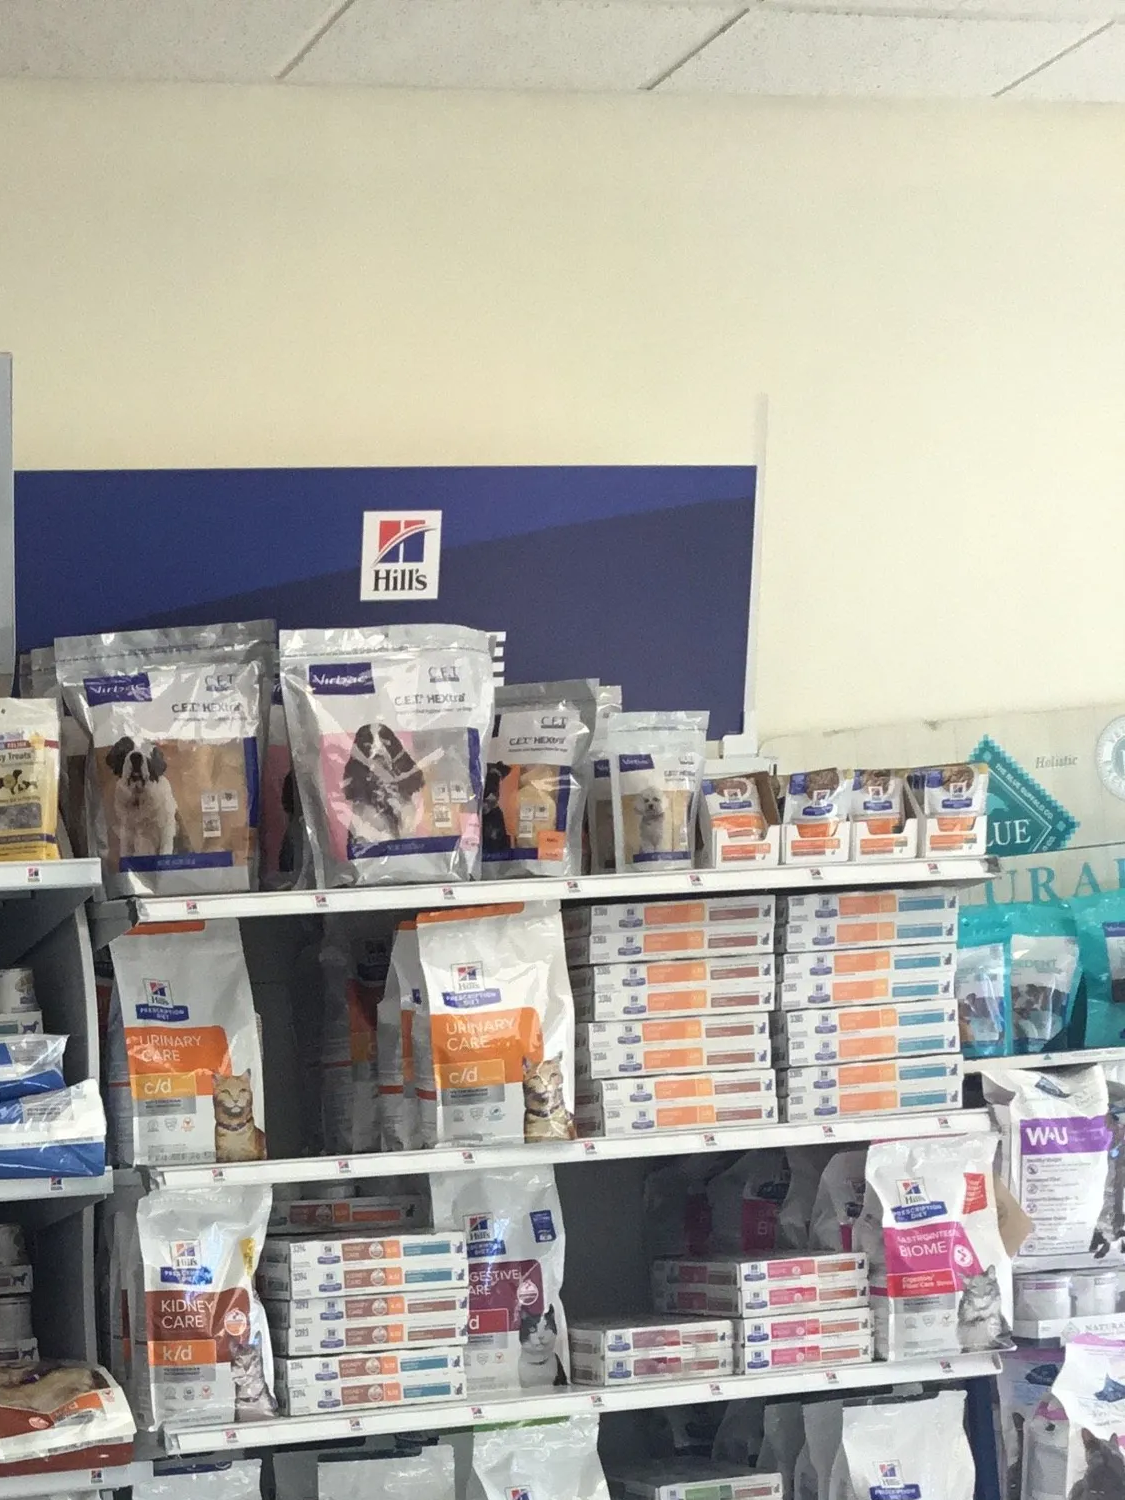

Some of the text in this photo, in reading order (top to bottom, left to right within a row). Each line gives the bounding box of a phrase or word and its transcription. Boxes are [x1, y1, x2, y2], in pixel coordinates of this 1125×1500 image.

[373, 568, 428, 591] Hill's
[312, 672, 369, 688] Virbac
[8, 752, 31, 760] Treats
[1036, 756, 1079, 769] Holistic
[446, 1016, 516, 1034] URINARY
[140, 1035, 202, 1047] URINARY
[447, 1036, 491, 1051] CARE
[143, 1050, 181, 1062] CARE
[449, 1067, 478, 1084] c/d
[144, 1078, 172, 1094] c/d
[1025, 1126, 1069, 1146] W+U
[899, 1241, 947, 1258] BIOME
[469, 1269, 519, 1282] GESTIVE
[469, 1285, 491, 1296] ARE
[161, 1300, 214, 1313] KIDNEY
[161, 1315, 204, 1329] CARE
[163, 1346, 192, 1361] k/d
